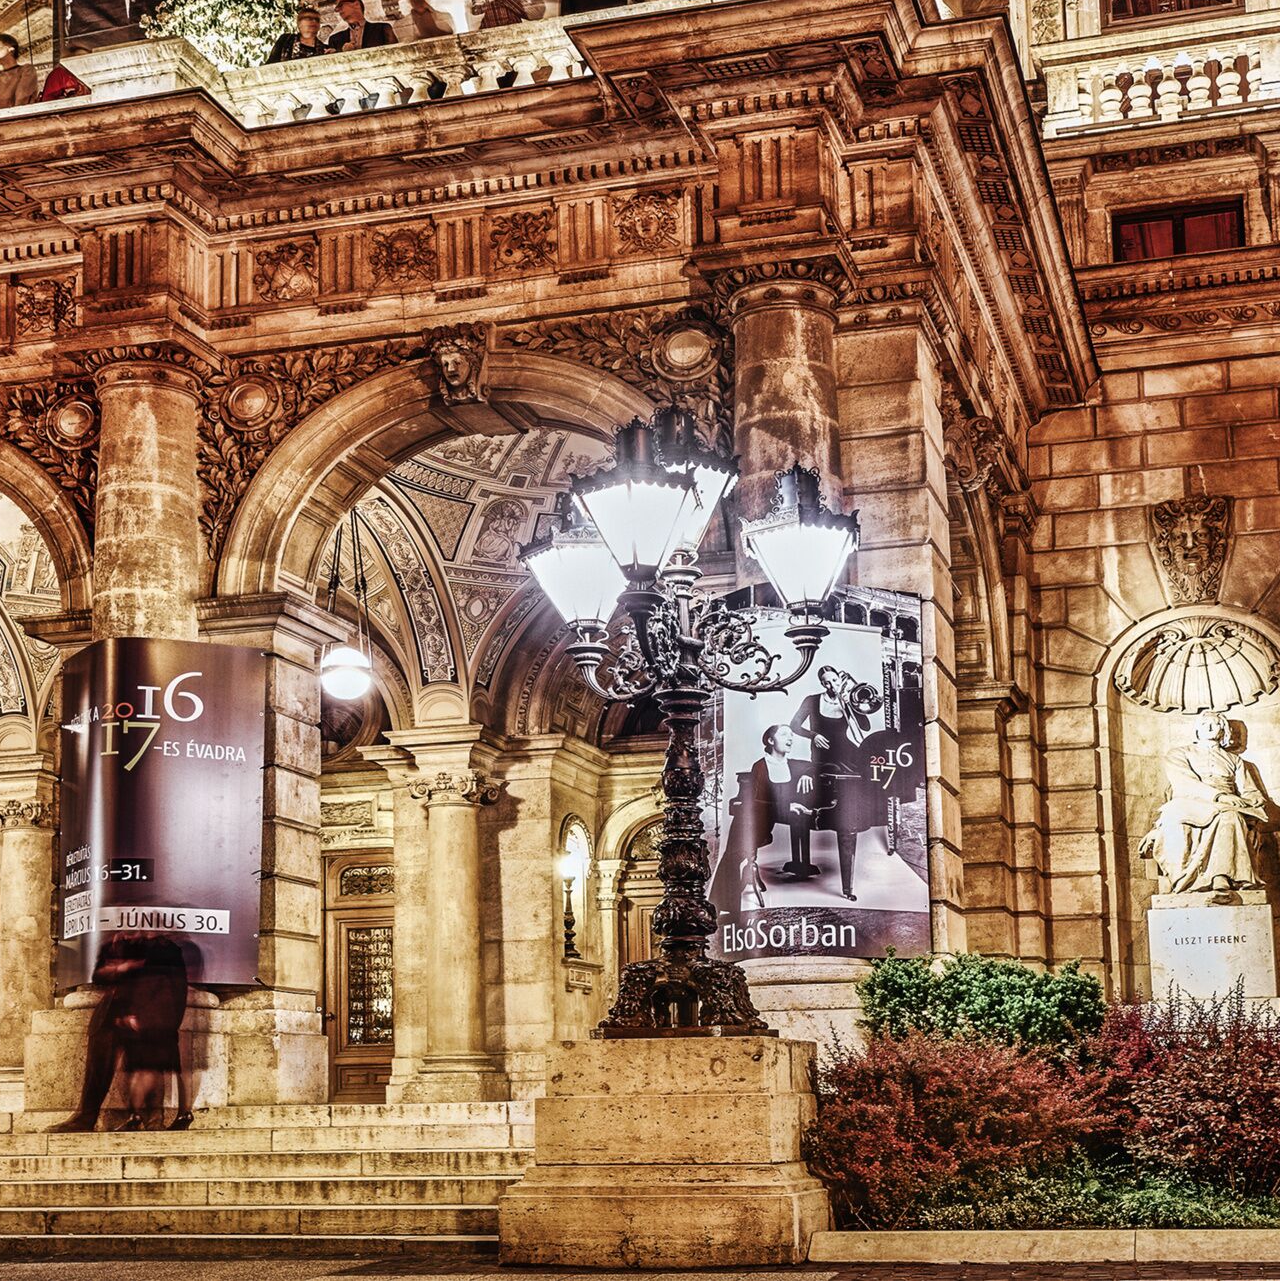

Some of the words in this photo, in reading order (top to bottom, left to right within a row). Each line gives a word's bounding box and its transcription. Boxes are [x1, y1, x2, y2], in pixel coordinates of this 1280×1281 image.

[186, 739, 247, 762] ÉVADRA
[116, 907, 186, 930] JÚNIUS
[194, 915, 224, 932] 30.
[723, 916, 857, 954] ElsőSorban
[1174, 935, 1203, 945] LISZT
[1207, 934, 1247, 945] FERENC
